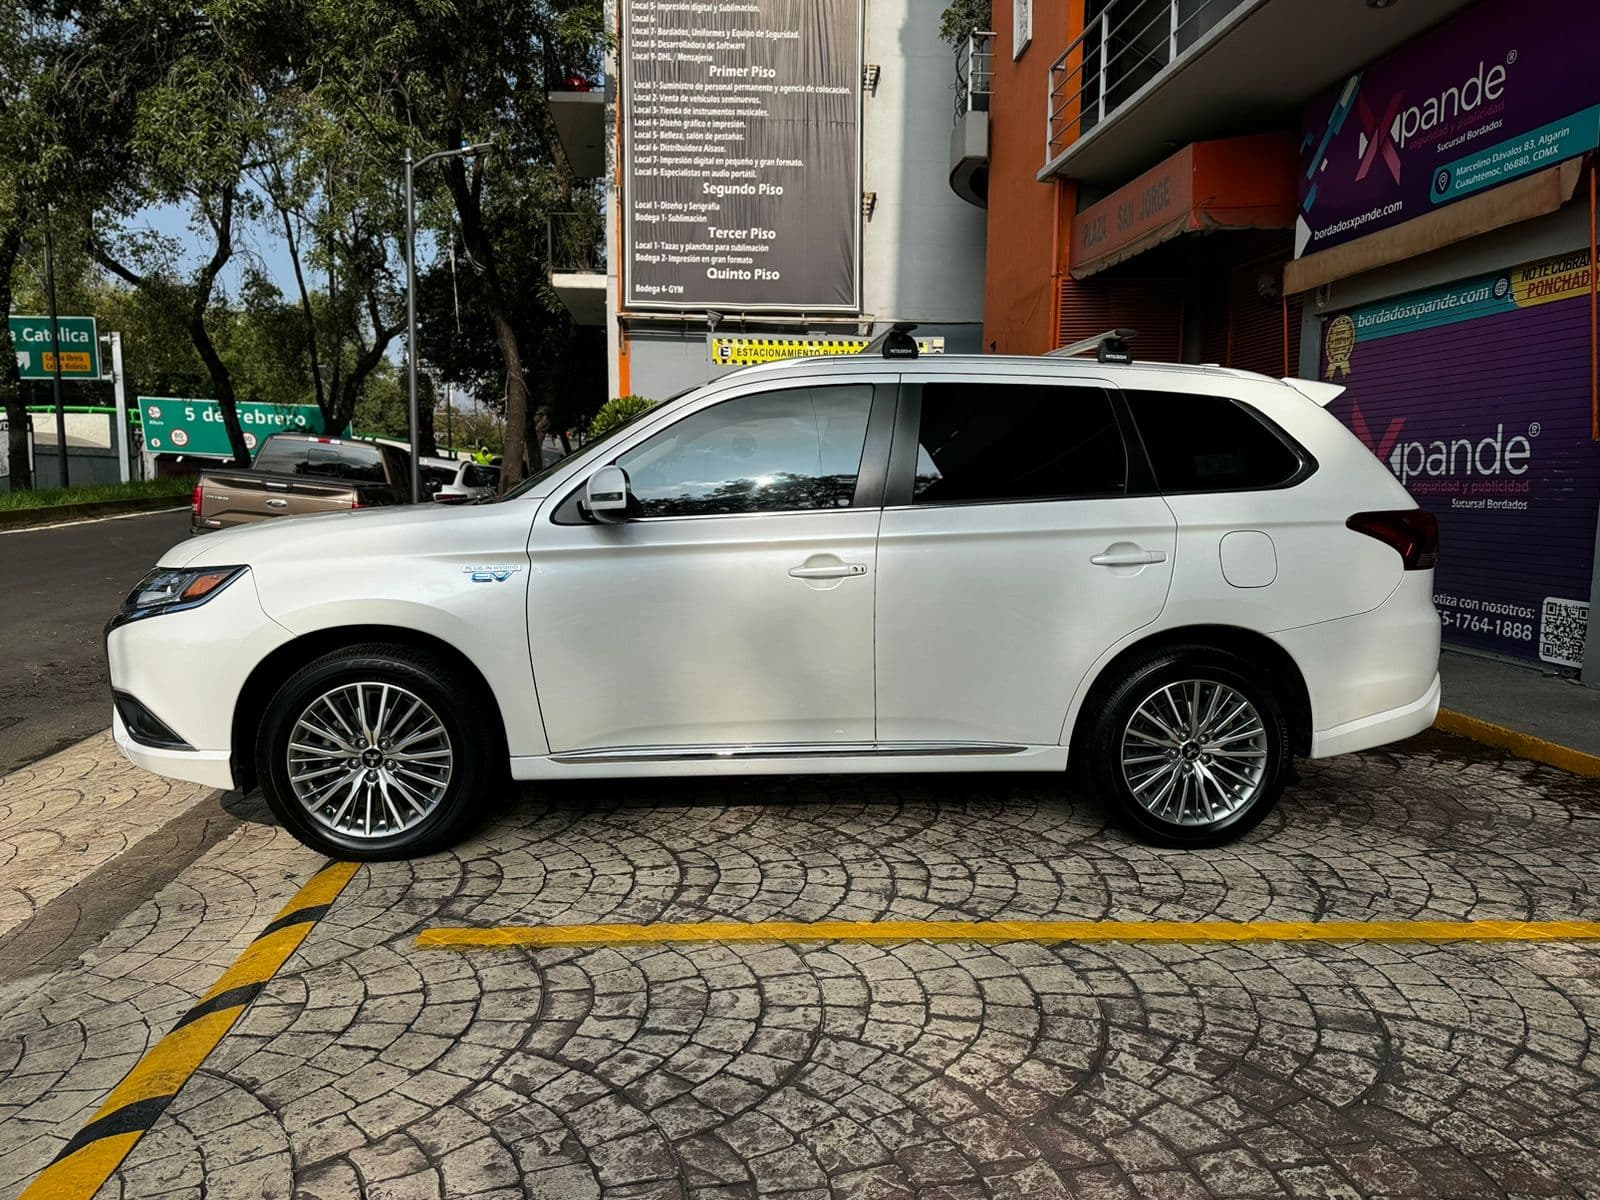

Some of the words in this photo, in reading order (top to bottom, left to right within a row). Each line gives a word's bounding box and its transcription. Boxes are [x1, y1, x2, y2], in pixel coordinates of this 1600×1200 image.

[632, 2, 649, 10] Local
[657, 3, 689, 12] Impresión
[691, 3, 712, 13] digital
[632, 14, 649, 22] Local
[632, 27, 649, 35] Local
[691, 28, 725, 37] Uniformes
[731, 29, 754, 39] Equipo
[756, 30, 764, 38] de
[632, 40, 649, 48] Local
[657, 41, 705, 49] Desarrolladora
[707, 41, 715, 49] de
[632, 52, 649, 60] Local
[709, 65, 749, 77] Primer
[751, 66, 777, 78] Piso
[634, 81, 651, 89] Local
[659, 82, 694, 90] Suministro
[704, 83, 733, 92] personal
[734, 84, 773, 93] permanente
[779, 85, 805, 94] agencia
[806, 85, 814, 93] de
[634, 94, 651, 102] Local
[659, 94, 679, 102] Venta
[634, 106, 651, 114] Local
[659, 106, 682, 115] Tienda
[683, 107, 691, 115] de
[736, 109, 769, 117] musicales.
[634, 118, 652, 126] Local
[660, 119, 682, 127] Diseño
[634, 131, 652, 139] Local
[660, 131, 685, 140] Belleza,
[686, 131, 704, 140] salón
[705, 132, 713, 140] de
[1437, 133, 1466, 153] Sucursal
[1467, 119, 1503, 140] Bordados
[634, 143, 652, 151] Local
[660, 144, 702, 152] Distribuidora
[634, 155, 652, 163] Local
[660, 156, 692, 166] Impresión
[693, 156, 715, 167] digital
[725, 157, 753, 167] pequeño
[760, 159, 775, 168] gran
[776, 158, 804, 167] formato.
[1456, 157, 1491, 176] Marcelino
[1523, 139, 1536, 152] 83,
[1504, 156, 1531, 172] 06880,
[1532, 144, 1559, 161] CDMX
[634, 168, 652, 176] Local
[660, 168, 701, 178] Especialistas
[711, 169, 730, 177] audio
[703, 182, 756, 197] Segundo
[759, 183, 784, 195] Piso
[635, 201, 652, 209] Local
[660, 201, 682, 210] Diseño
[1083, 215, 1107, 248] PLAZA
[1118, 199, 1134, 232] SAN
[1140, 175, 1170, 219] JORGE
[635, 213, 660, 224] Bodega
[668, 214, 707, 222] Sublimación
[1314, 200, 1403, 240] bordadosxpande.com
[708, 227, 748, 239] Tercer
[750, 228, 777, 239] Piso
[635, 241, 652, 250] Local
[660, 242, 680, 250] Tazas
[685, 243, 714, 252] planchas
[715, 245, 730, 253] para
[731, 243, 769, 252] sublimación
[635, 253, 660, 264] Bodega
[668, 254, 700, 264] Impresión
[711, 256, 727, 265] gran
[727, 255, 753, 264] formato
[707, 268, 751, 280] Quinto
[754, 268, 780, 280] Piso
[1521, 264, 1537, 282] NO
[1538, 261, 1550, 278] TE
[635, 284, 660, 295] Bodega
[668, 285, 684, 294] GYM
[1357, 285, 1489, 328] bordadosxpande.com
[736, 347, 821, 357] ESTACIONAMIENTO
[185, 407, 195, 421] 5
[202, 407, 225, 422] de
[1412, 480, 1460, 493] seguridad
[1462, 482, 1469, 494] y
[1471, 480, 1529, 493] publicidad
[1451, 498, 1485, 508] Sucursal
[1487, 499, 1528, 510] Bordados
[1433, 593, 1457, 607] otiza
[1459, 598, 1479, 610] con
[1481, 601, 1535, 619] nosotros:
